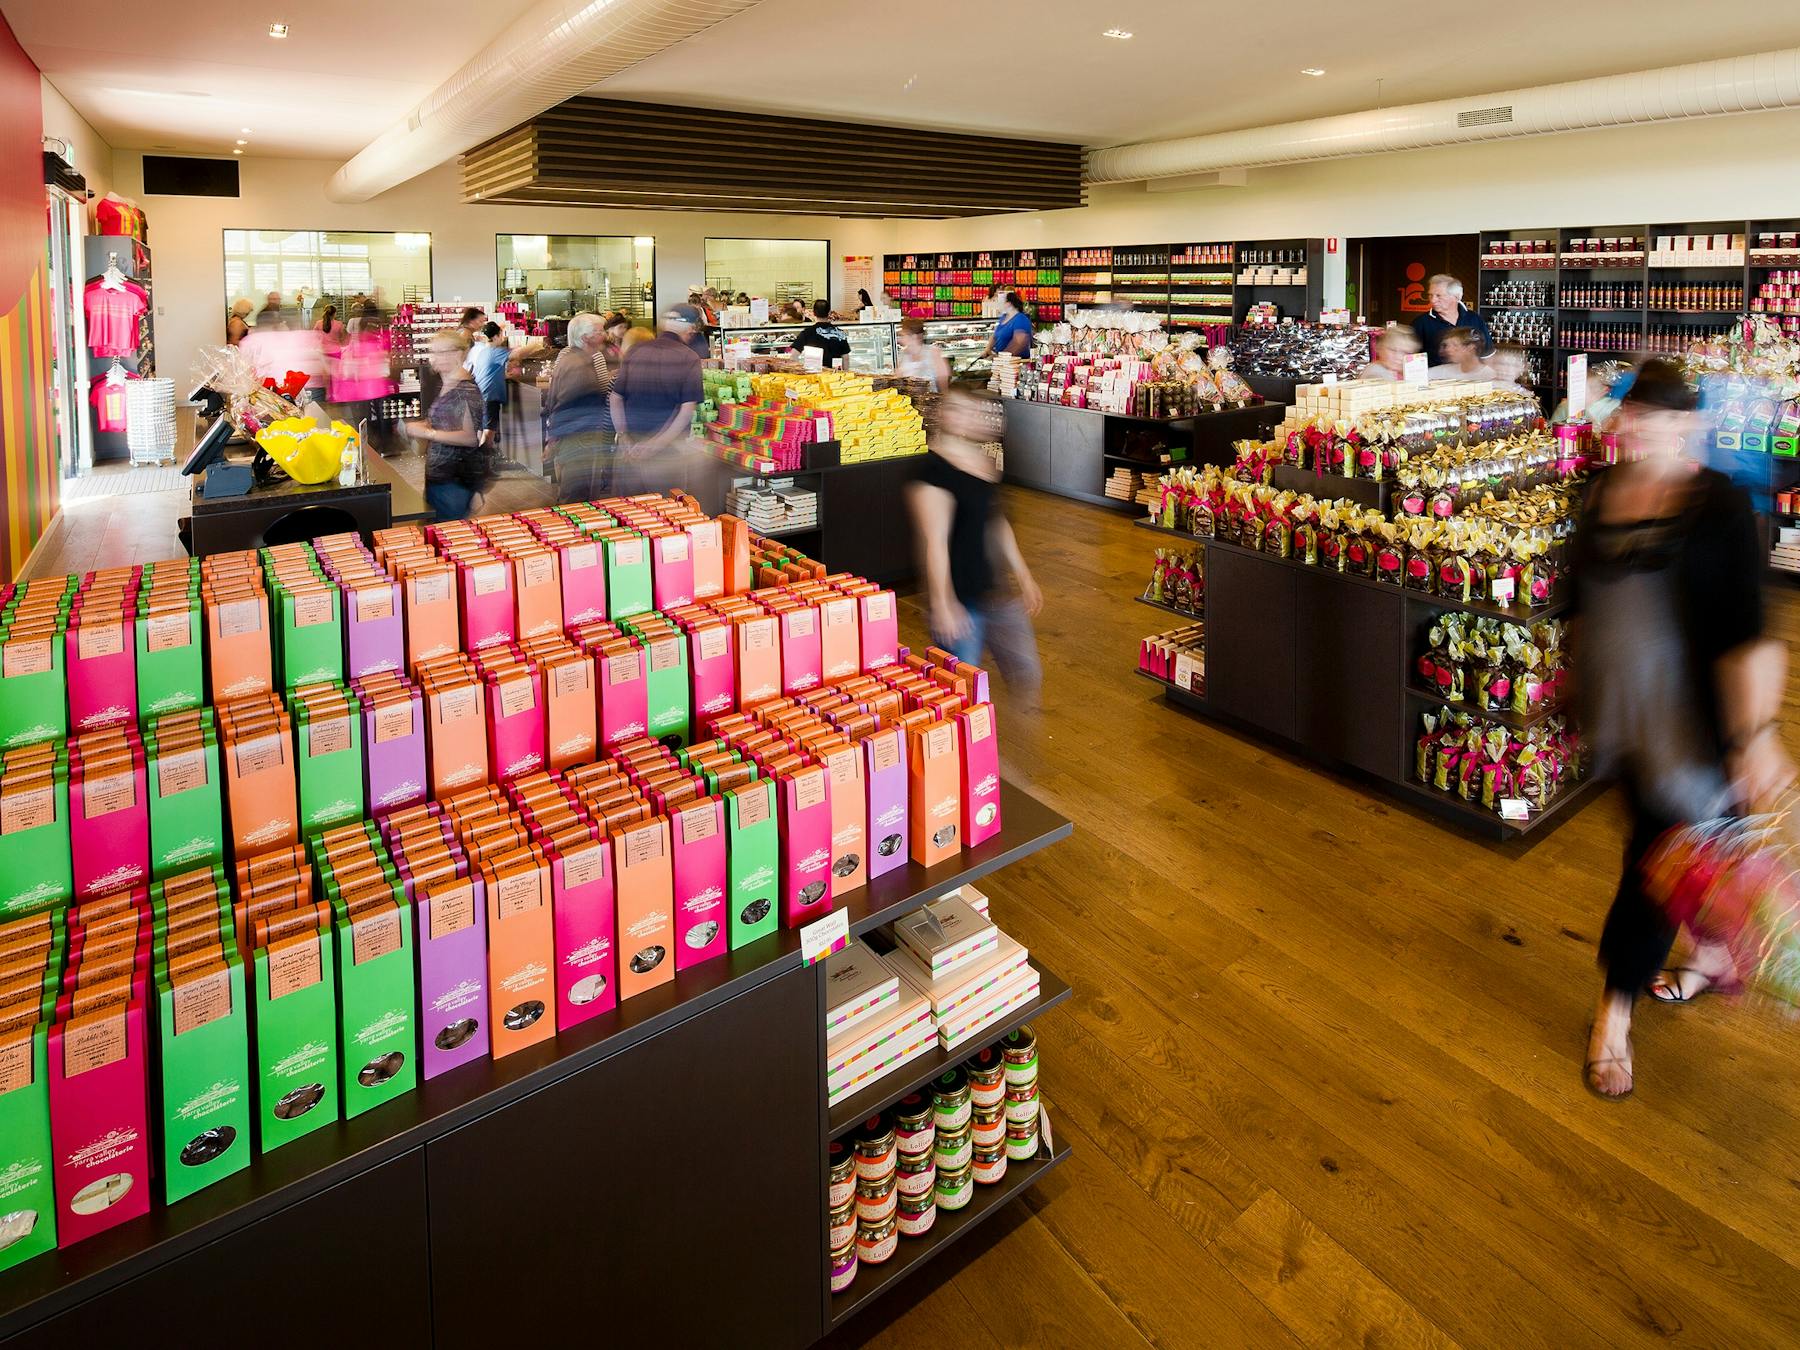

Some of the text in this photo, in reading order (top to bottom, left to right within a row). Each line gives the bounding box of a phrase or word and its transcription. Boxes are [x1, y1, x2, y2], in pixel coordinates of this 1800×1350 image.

[182, 1098, 222, 1120] yarra valley
[192, 1097, 236, 1120] chocolaterie
[1016, 1108, 1035, 1118] Lollies
[910, 1139, 931, 1150] Lollies
[74, 1148, 117, 1168] yarra valley
[86, 1145, 134, 1168] chocolaterie
[908, 1180, 930, 1190] Lollies
